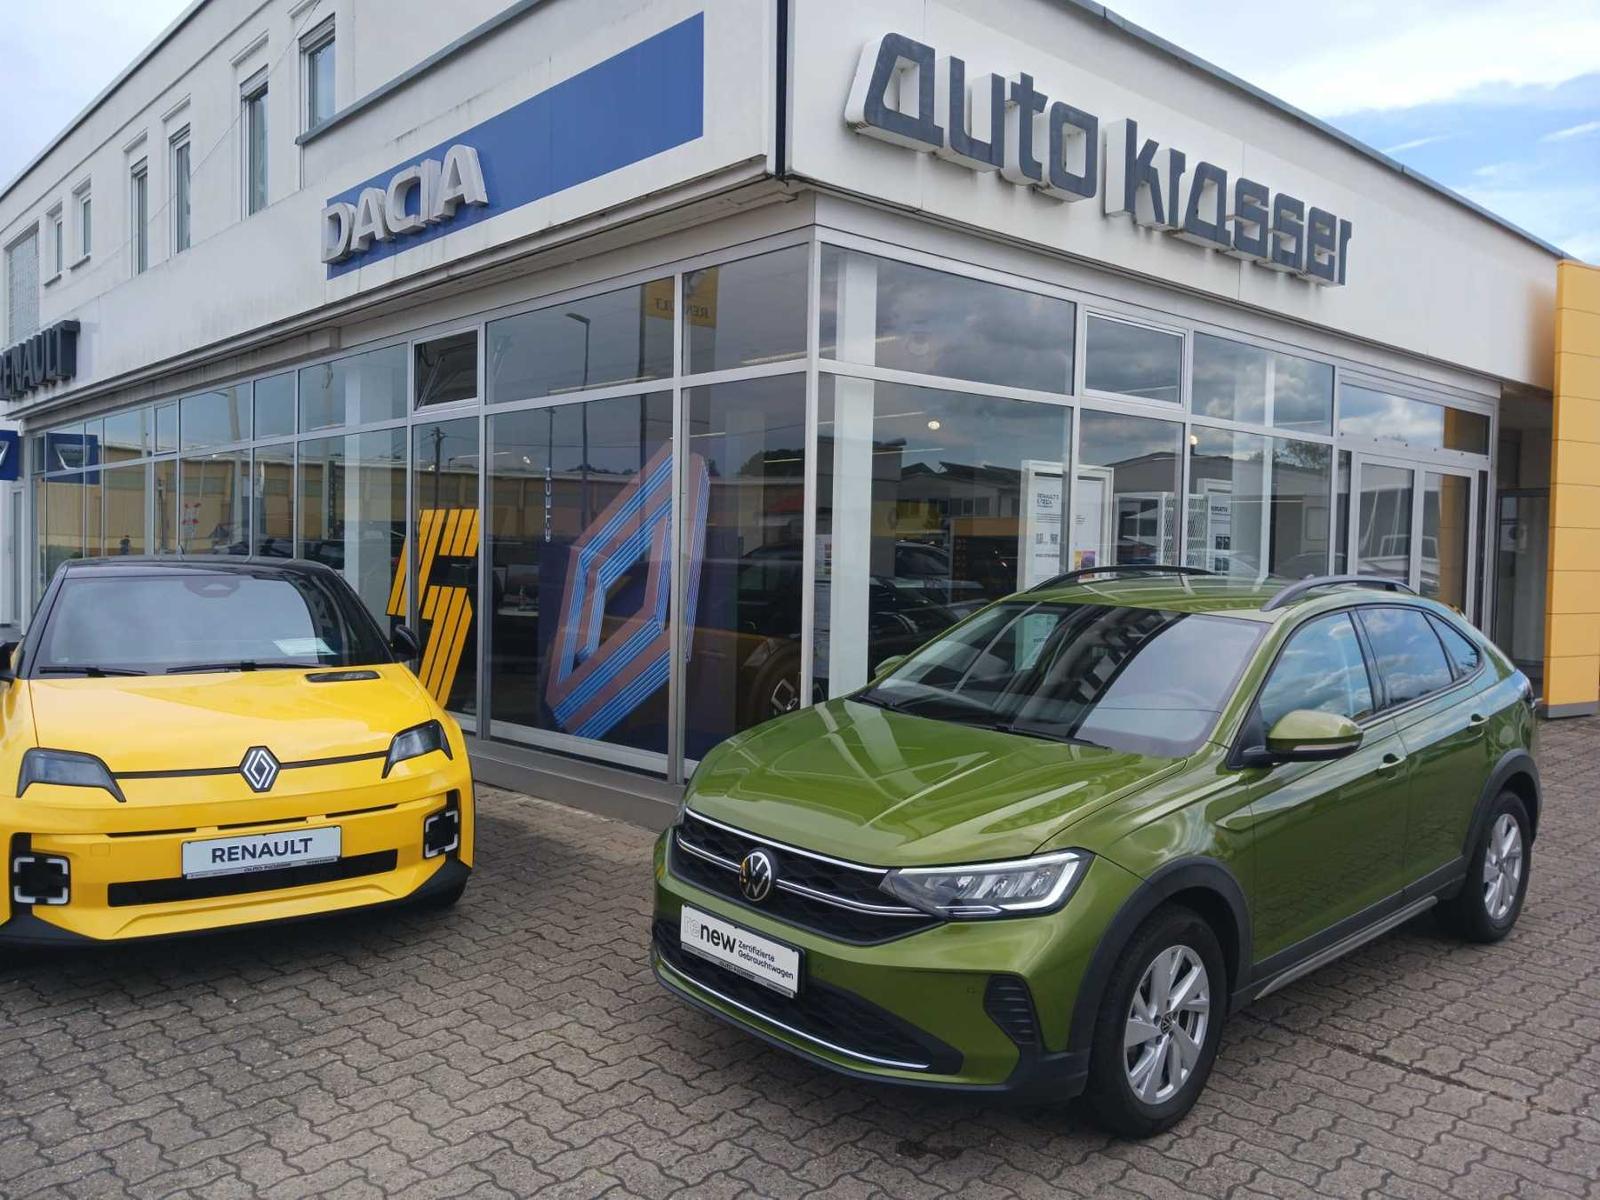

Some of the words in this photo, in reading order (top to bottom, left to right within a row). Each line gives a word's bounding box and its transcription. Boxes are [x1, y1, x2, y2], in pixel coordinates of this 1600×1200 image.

[321, 144, 489, 264] DACIA
[211, 837, 313, 864] RENAULT
[738, 940, 775, 962] Zertifizierte
[738, 949, 794, 980] Gebrauchtwagen
